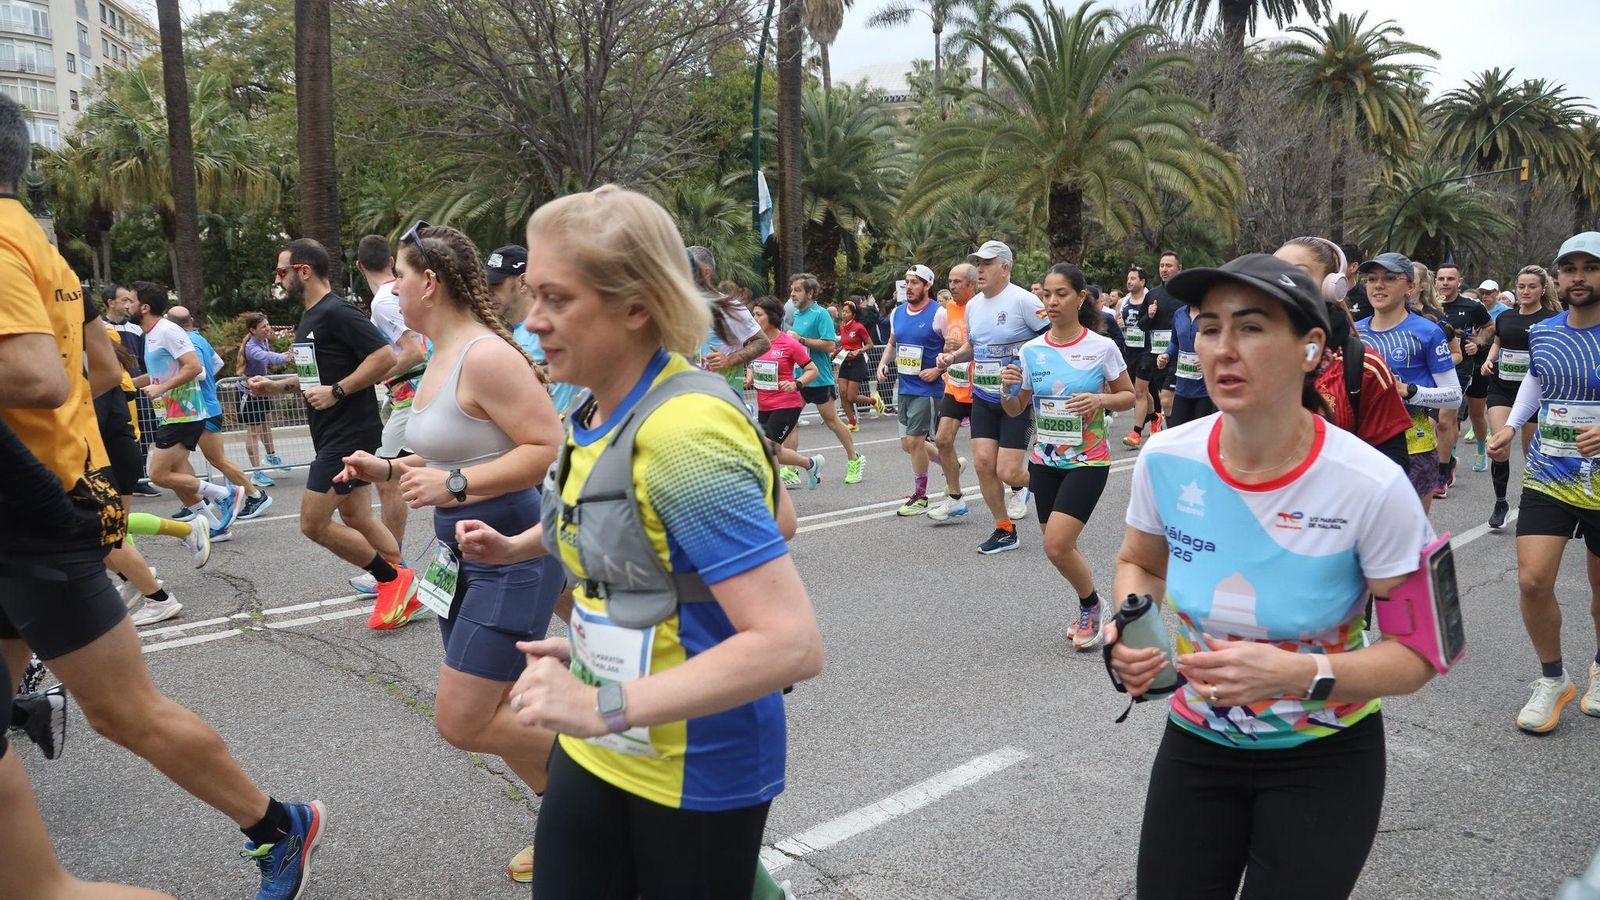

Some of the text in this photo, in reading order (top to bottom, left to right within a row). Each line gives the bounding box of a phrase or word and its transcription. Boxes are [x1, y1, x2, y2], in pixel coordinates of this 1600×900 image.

[900, 358, 917, 367] 1035
[1503, 363, 1527, 373] 5992
[977, 374, 997, 385] 4112
[1043, 418, 1073, 432] 6269
[1165, 525, 1217, 553] álaga
